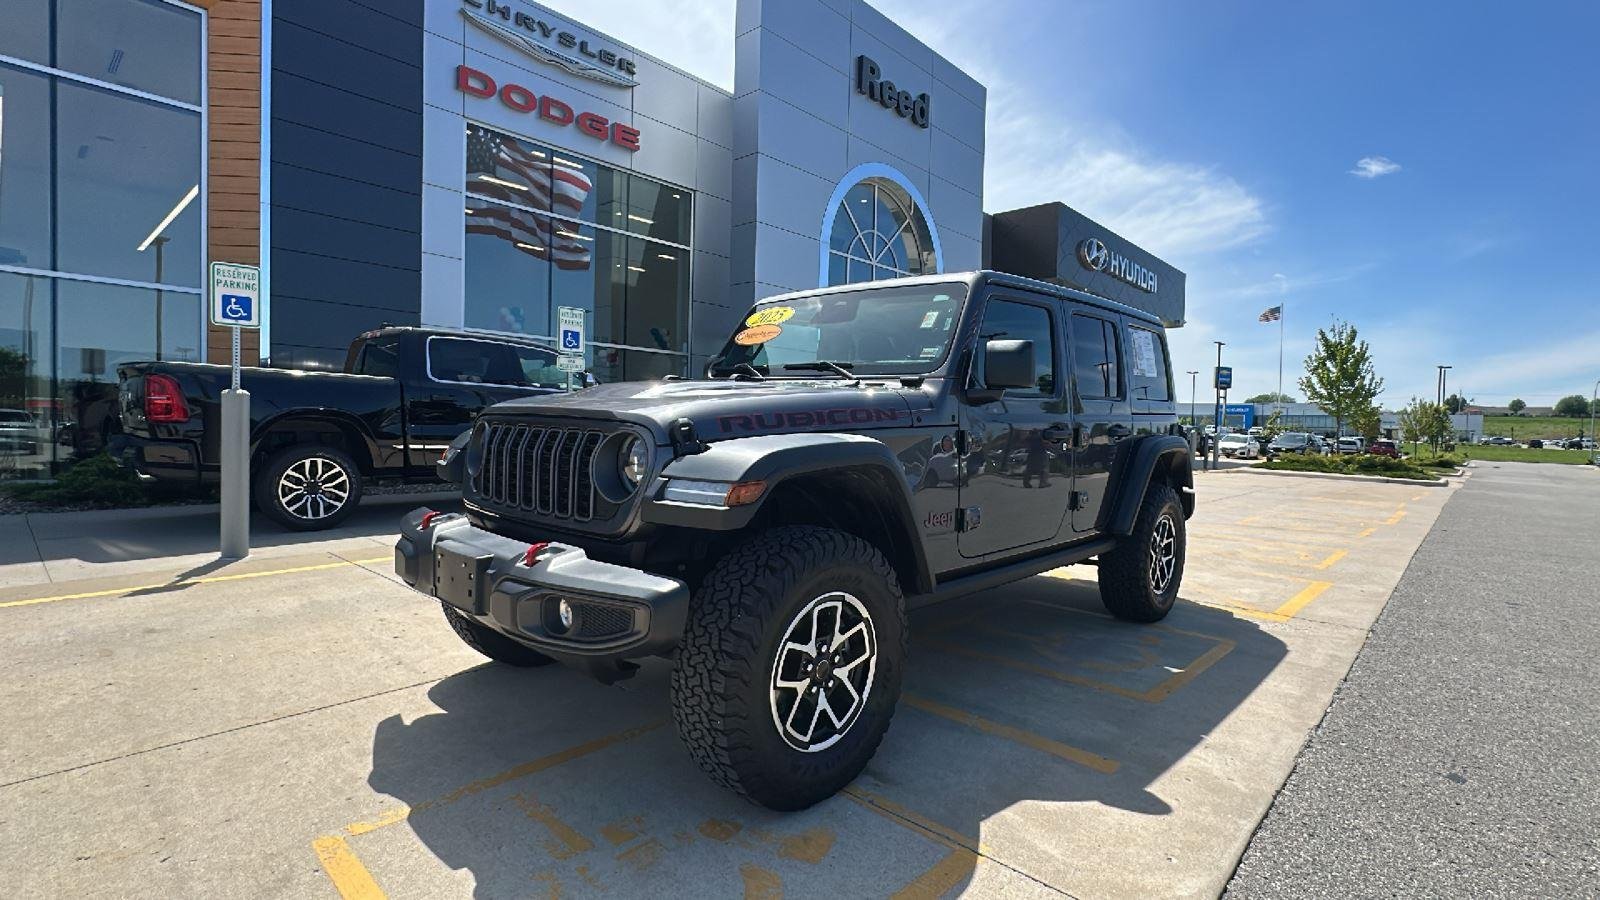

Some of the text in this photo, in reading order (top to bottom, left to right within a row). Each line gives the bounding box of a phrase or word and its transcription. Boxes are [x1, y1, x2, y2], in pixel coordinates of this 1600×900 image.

[857, 54, 931, 129] Reed
[456, 64, 641, 151] DODGE
[216, 268, 257, 281] RESERVED
[1110, 251, 1158, 293] HYUNDAI
[216, 279, 257, 292] PARKING
[717, 407, 897, 432] RUBICON
[923, 511, 953, 529] Jeep
